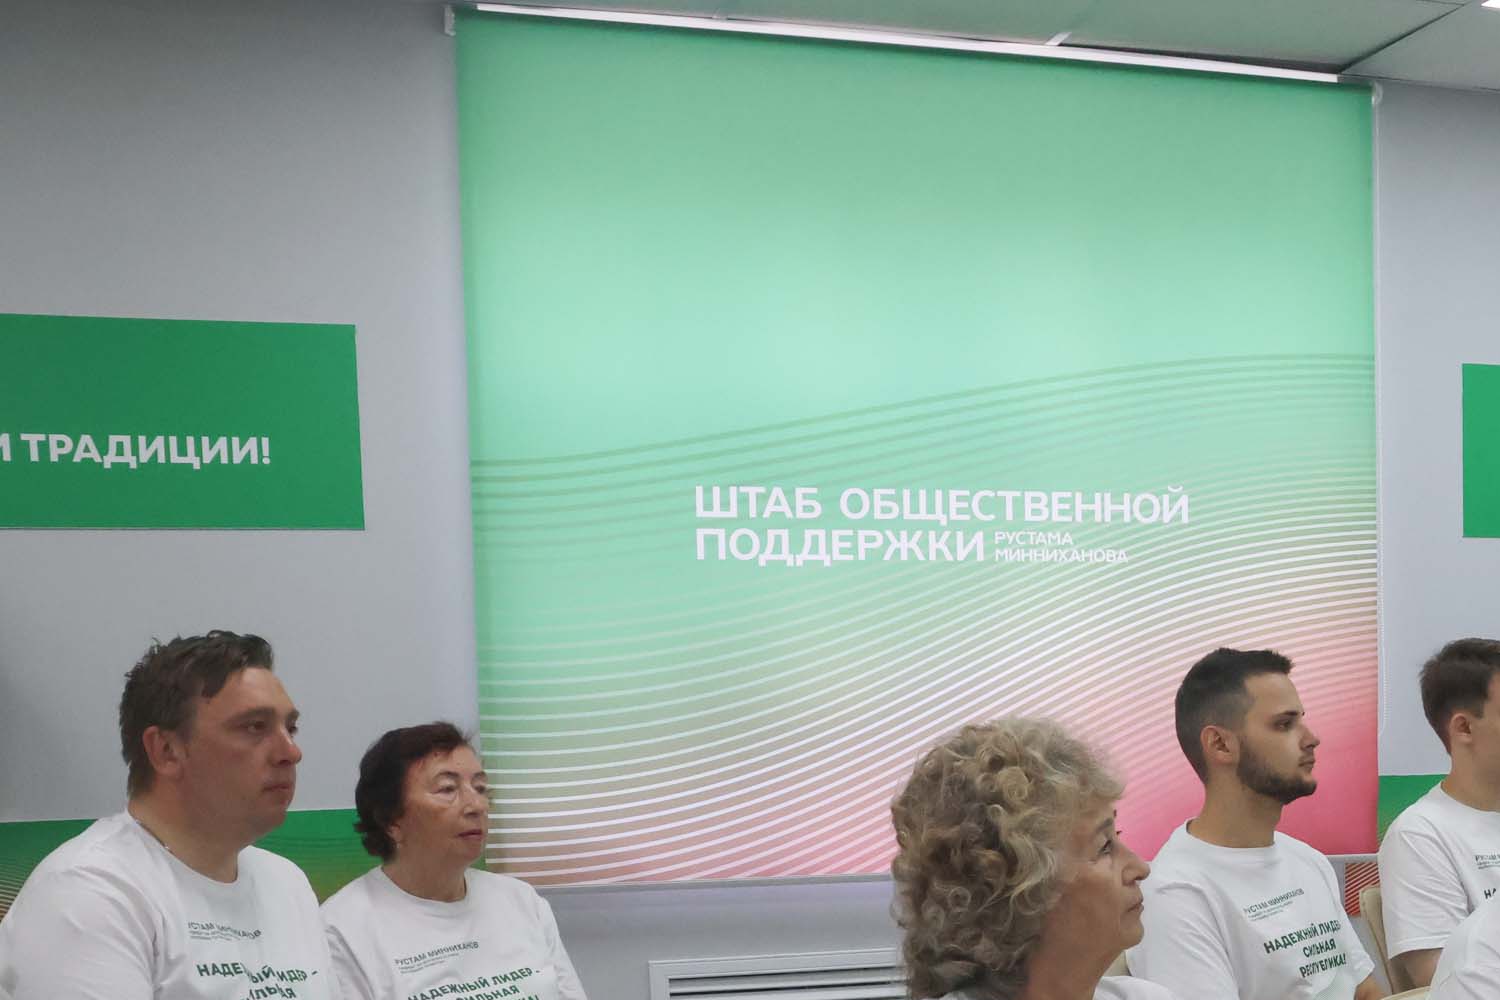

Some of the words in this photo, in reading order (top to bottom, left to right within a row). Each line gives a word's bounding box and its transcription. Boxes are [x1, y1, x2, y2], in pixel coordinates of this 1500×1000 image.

[20, 433, 271, 470] ТРАДИЦИИ!
[695, 485, 822, 519] ШТАБ
[839, 486, 1190, 526] ОБЩЕСТВЕННОЙ
[695, 528, 985, 567] ПОДДЕРЖКИ
[995, 531, 1074, 546] РУСТАМА
[995, 547, 1129, 563] МИННИХАНОВА
[492, 967, 533, 986] ЛИДЕР
